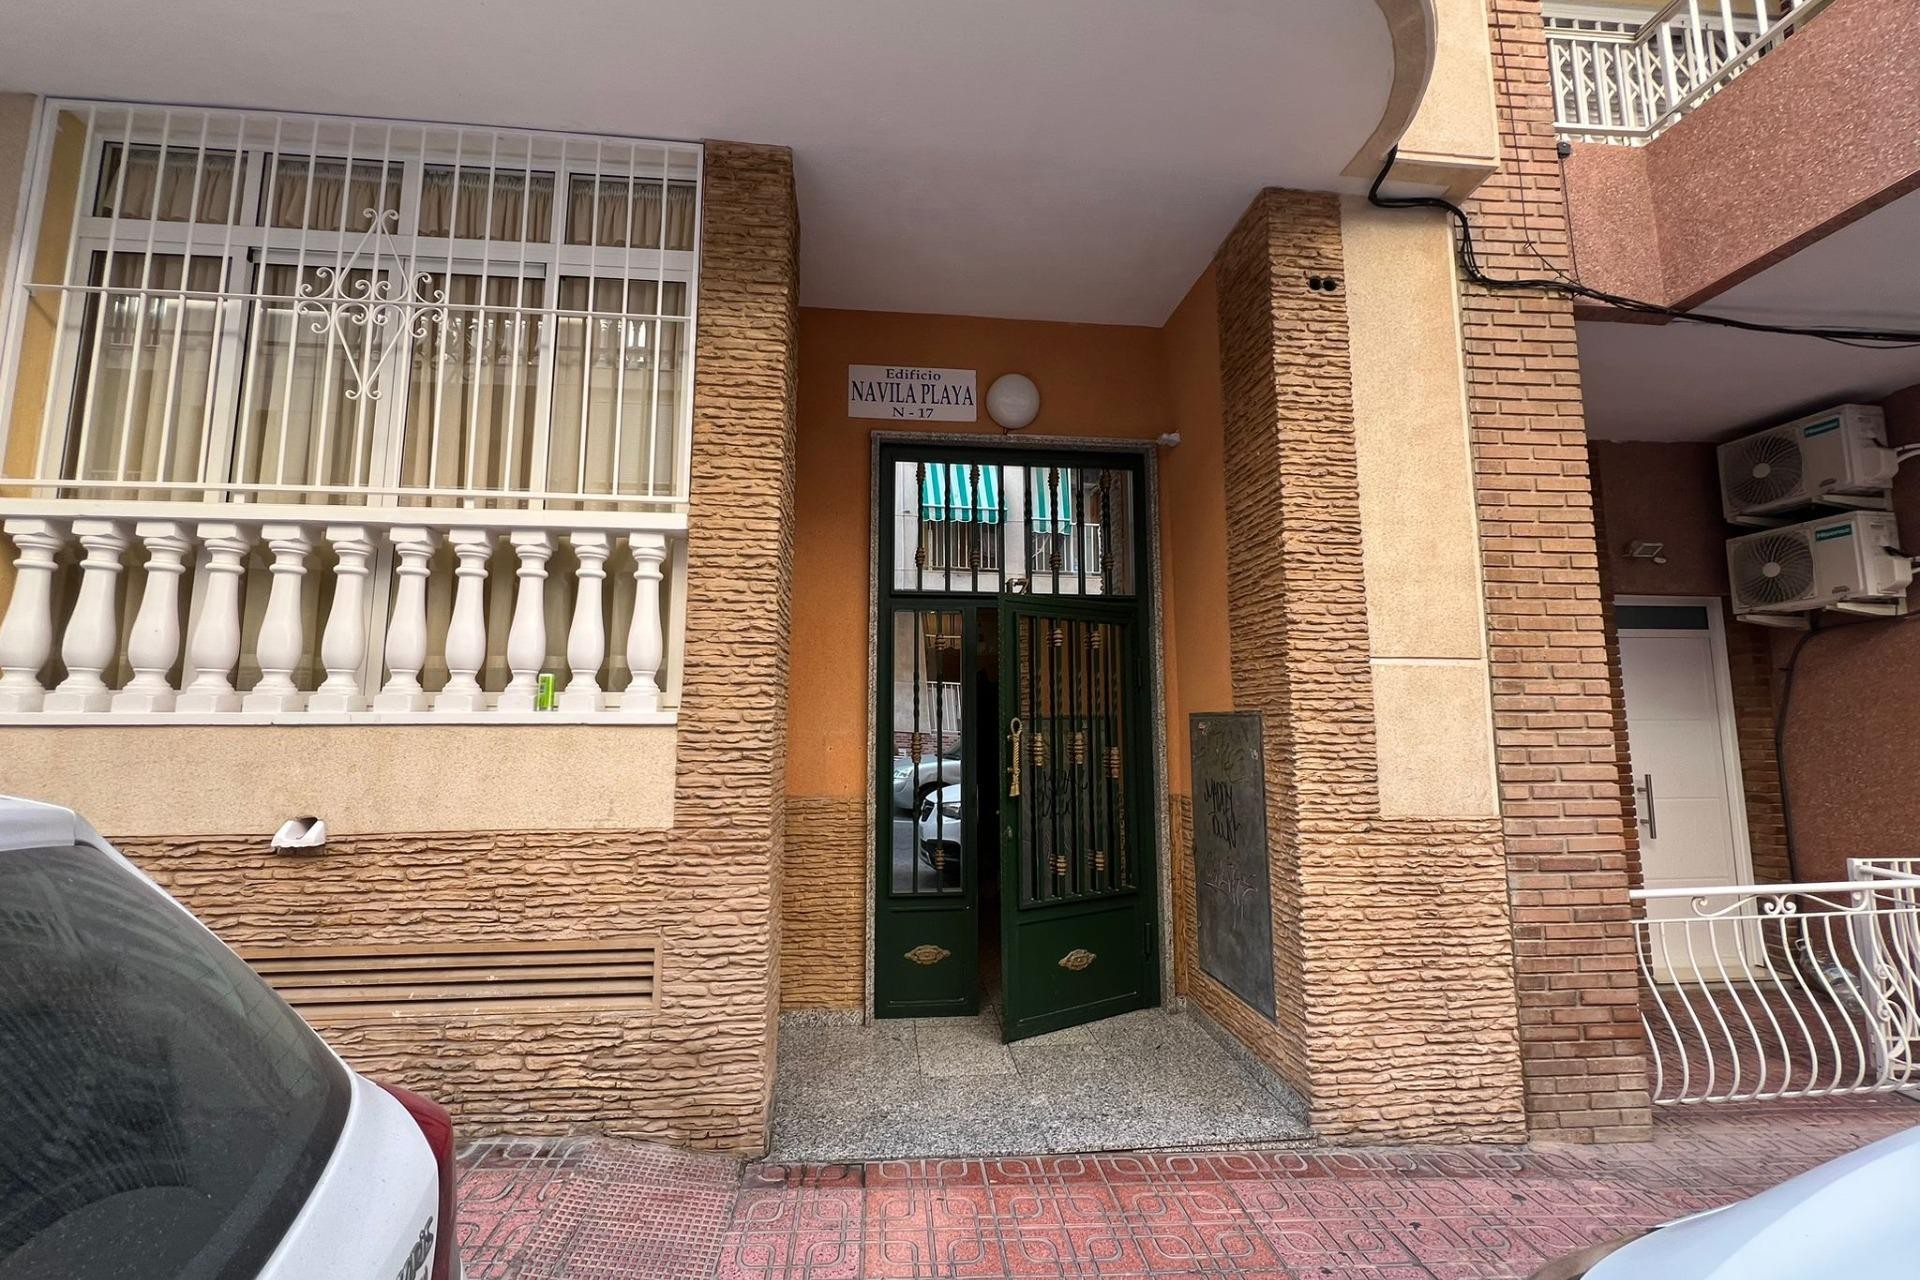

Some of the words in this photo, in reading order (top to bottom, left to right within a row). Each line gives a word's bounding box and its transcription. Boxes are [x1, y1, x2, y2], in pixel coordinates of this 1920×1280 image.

[886, 368, 941, 381] Edificio
[851, 380, 916, 404] NAVILA
[920, 383, 974, 406] PLAYA
